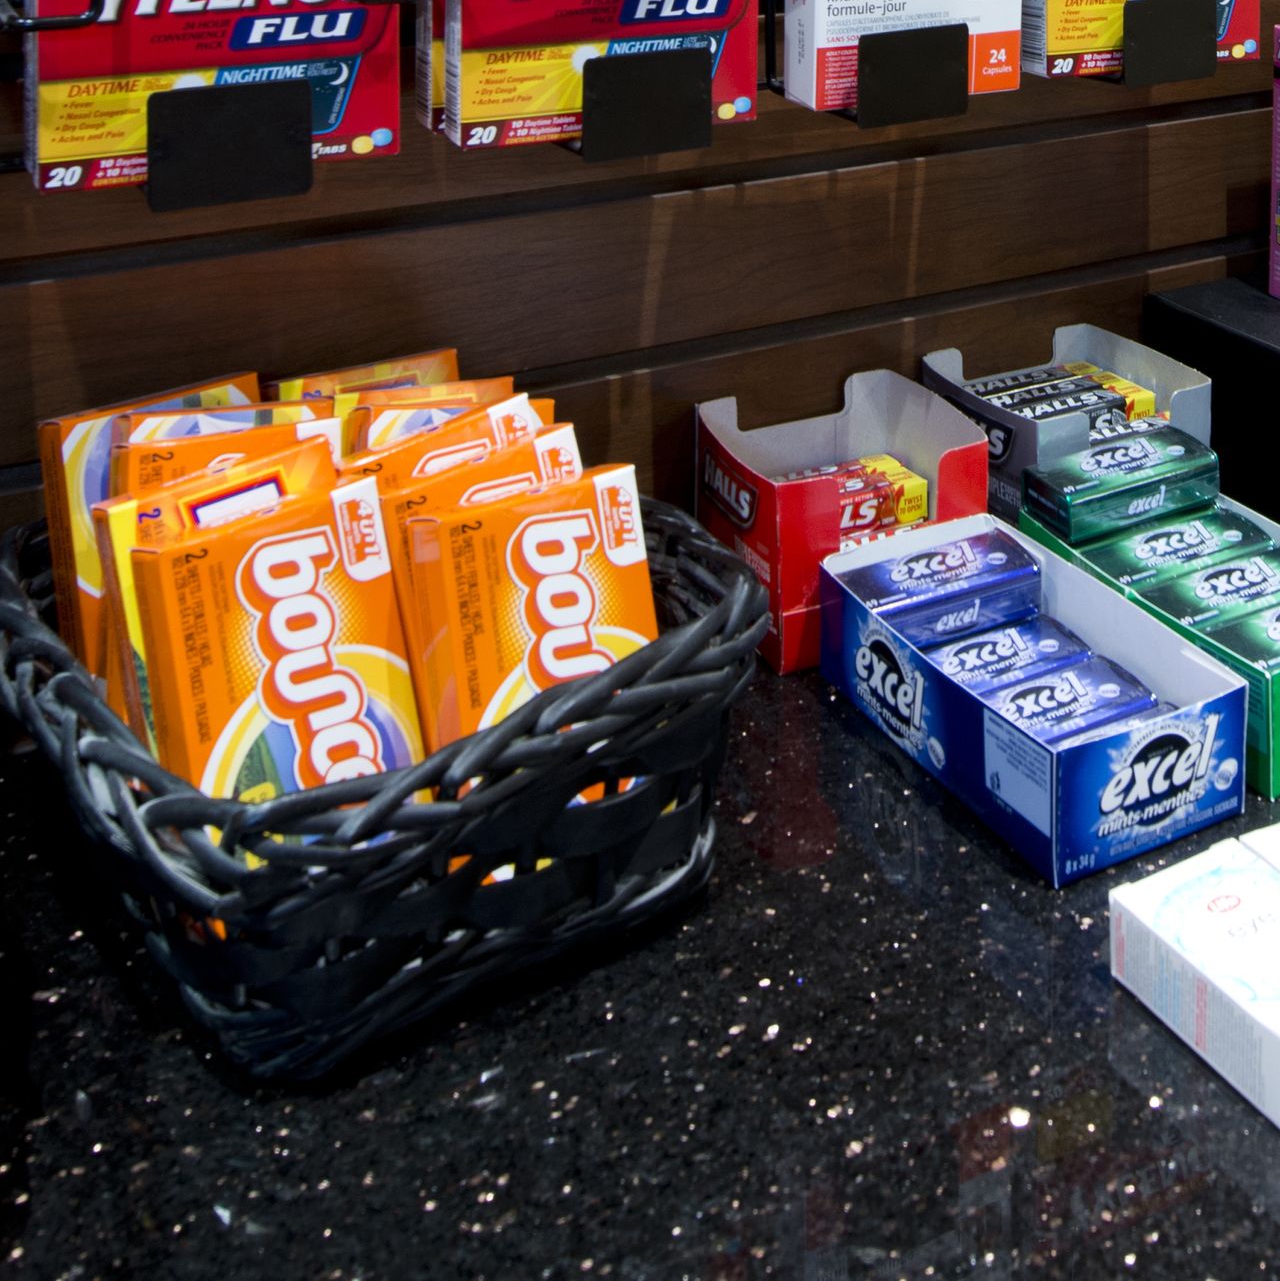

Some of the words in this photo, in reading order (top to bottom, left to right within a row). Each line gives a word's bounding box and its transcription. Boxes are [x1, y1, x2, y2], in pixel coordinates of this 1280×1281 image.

[827, 0, 907, 17] formule-jour
[247, 12, 353, 44] FLU
[486, 49, 545, 66] DAYTIME
[611, 38, 683, 55] NIGHTTIME
[989, 48, 1007, 64] 24
[1051, 58, 1074, 74] 20
[67, 79, 140, 98] DAYTIME
[220, 64, 308, 85] NIGHTTIME
[982, 65, 1013, 76] Capsules
[466, 125, 497, 145] 20
[45, 165, 82, 189] 20
[963, 369, 1055, 394] HALLS
[991, 380, 1077, 407] HALLS
[1017, 390, 1100, 419] HALLS
[1080, 437, 1158, 473] excel
[703, 452, 752, 519] HALLS
[903, 495, 923, 507] TWIST
[1128, 485, 1166, 516] excel
[1135, 520, 1215, 560] excel
[890, 540, 978, 582] excel
[1195, 556, 1276, 599] excel
[936, 599, 981, 632] excel
[942, 627, 1029, 675] excel
[855, 643, 925, 731] excel
[1001, 670, 1090, 719] excel
[1100, 714, 1219, 815] excel
